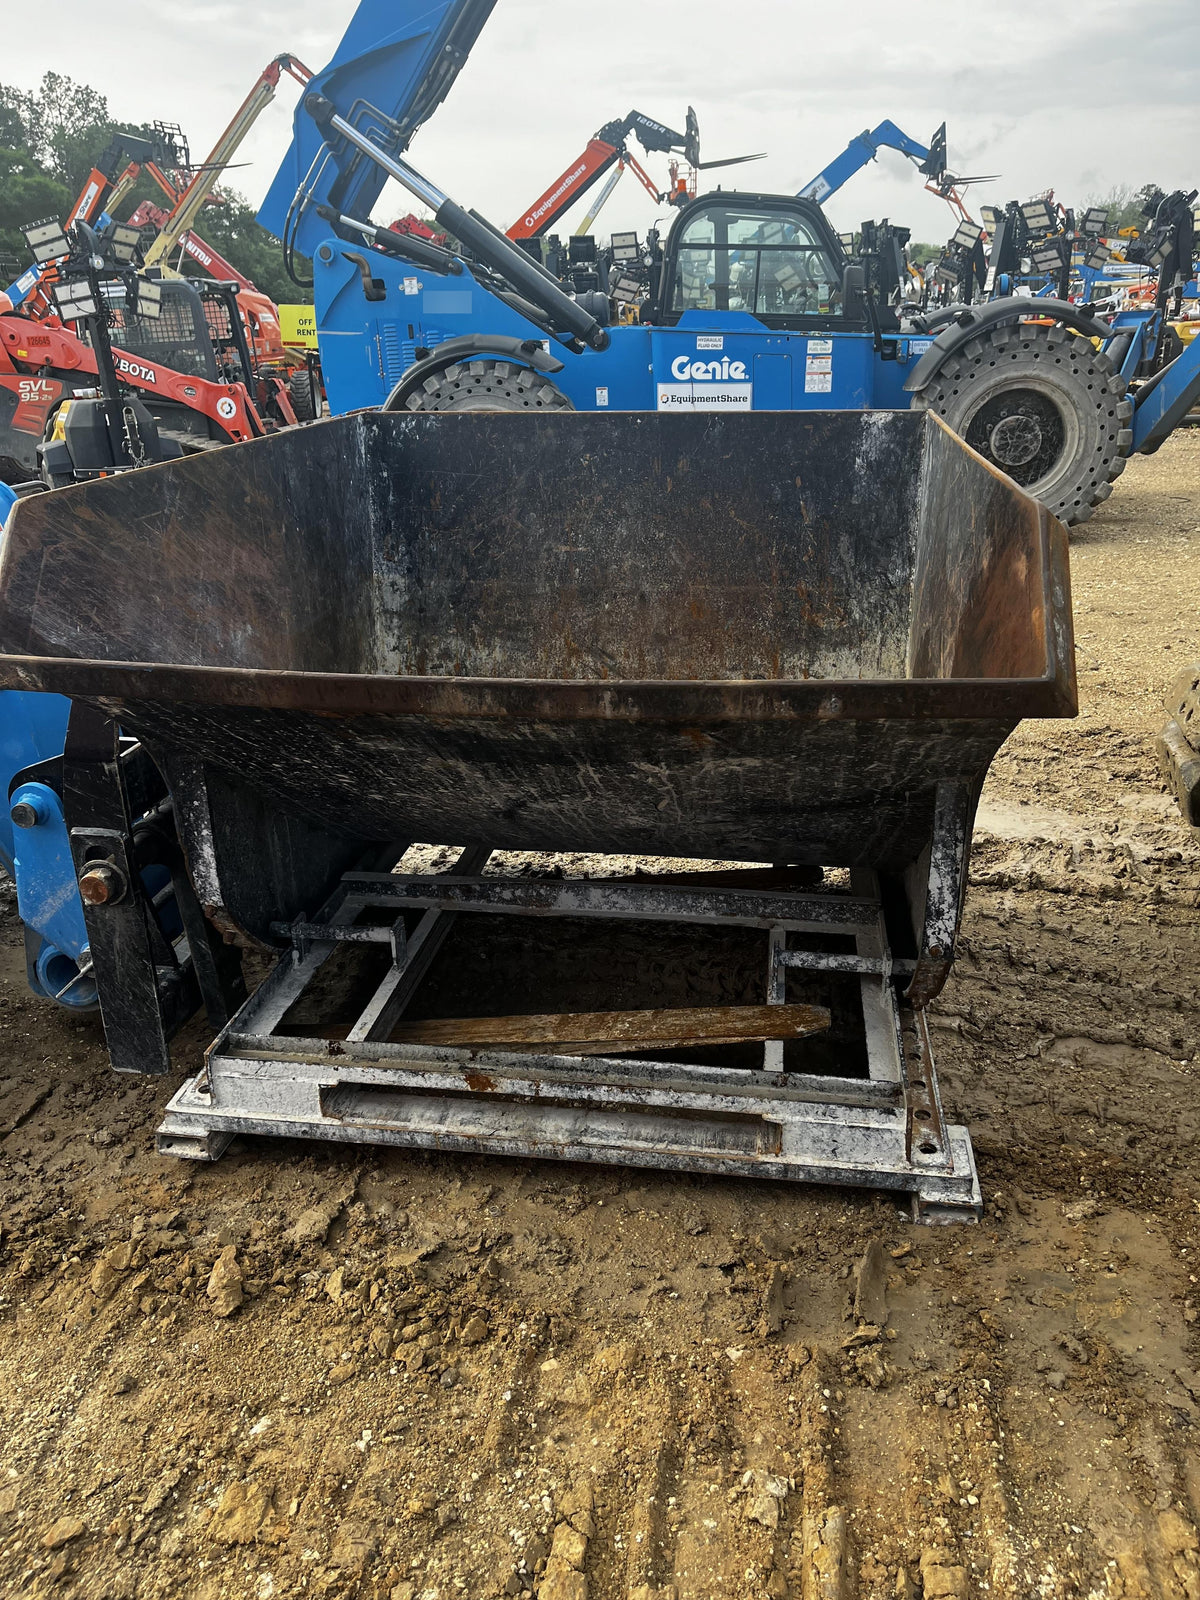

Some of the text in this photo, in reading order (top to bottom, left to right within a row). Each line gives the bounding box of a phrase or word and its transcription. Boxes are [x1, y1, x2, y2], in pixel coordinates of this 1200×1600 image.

[531, 163, 587, 220] EquipmentShare
[298, 318, 313, 326] OFF
[671, 355, 746, 380] Genie
[18, 379, 54, 393] SVL
[670, 394, 748, 405] EquipmentShare
